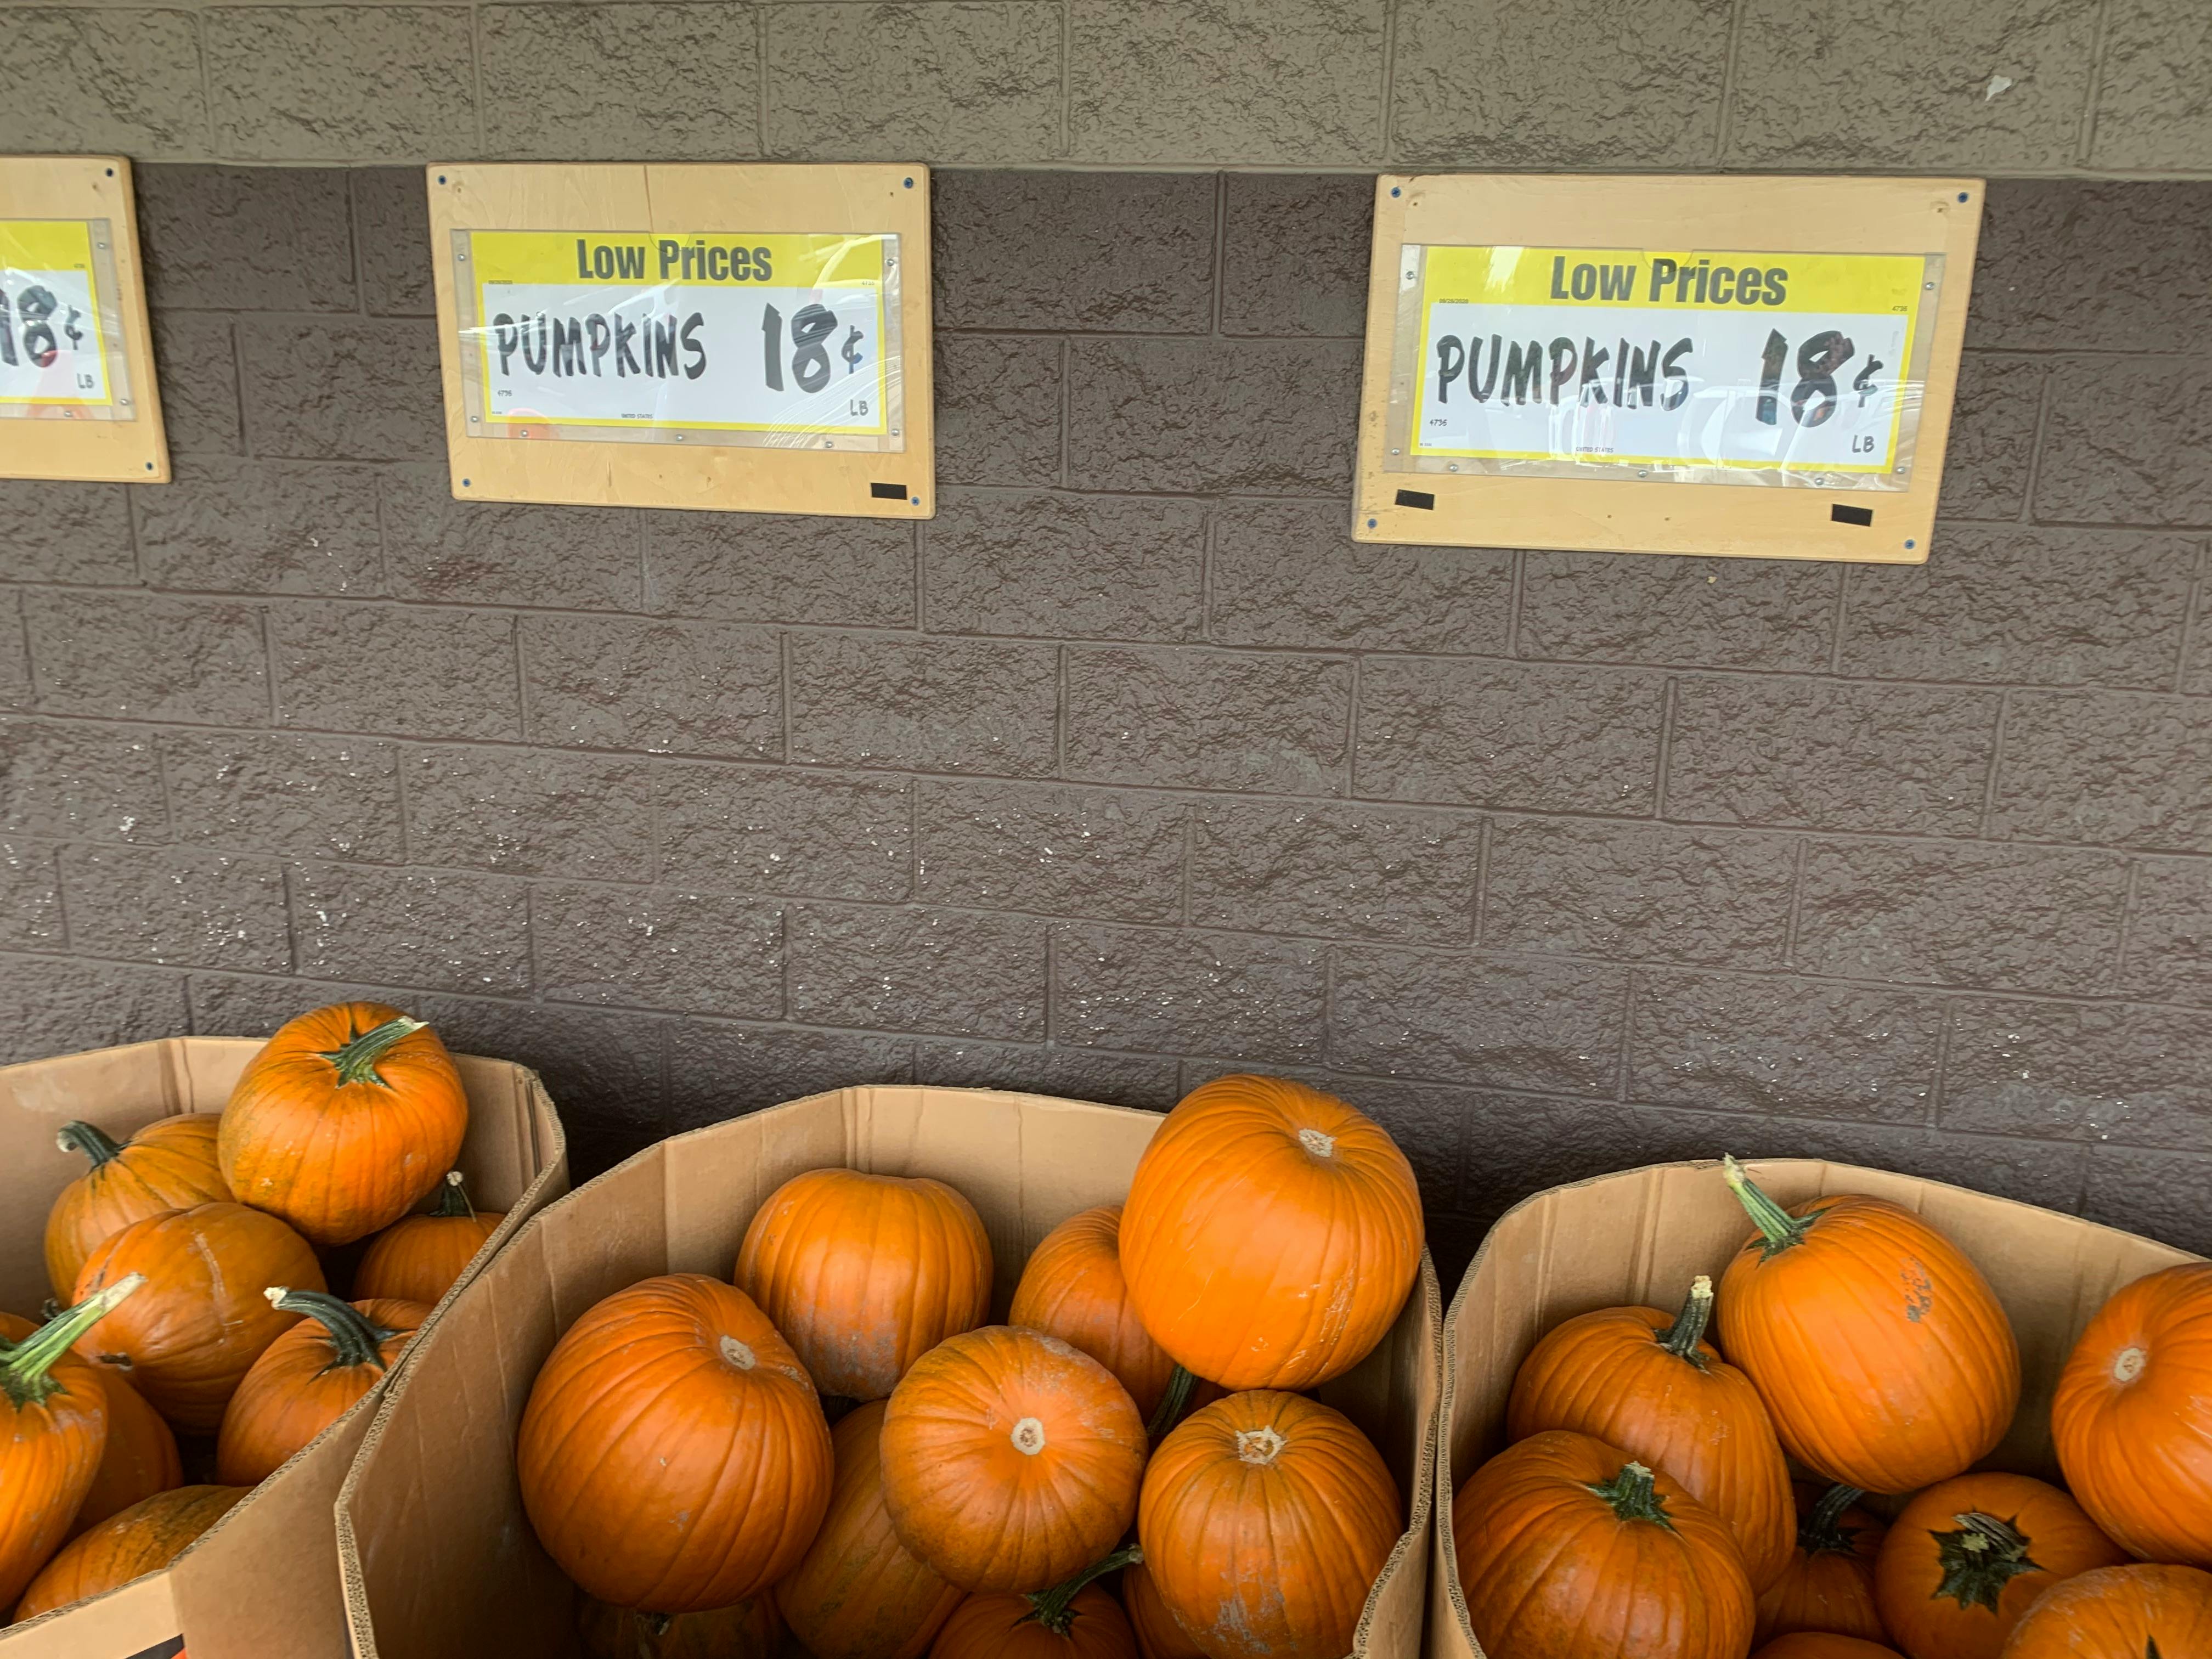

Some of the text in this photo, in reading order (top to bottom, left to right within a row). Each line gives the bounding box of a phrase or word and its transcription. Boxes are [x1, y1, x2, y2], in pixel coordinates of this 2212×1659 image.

[576, 239, 773, 281] Low Prices
[1550, 256, 1788, 306] Low Prices
[493, 312, 707, 380] PUMPKINS
[77, 373, 94, 388] LB
[1436, 334, 1694, 411] PUMPKINS
[850, 399, 868, 416] LB
[1852, 435, 1875, 453] LB
